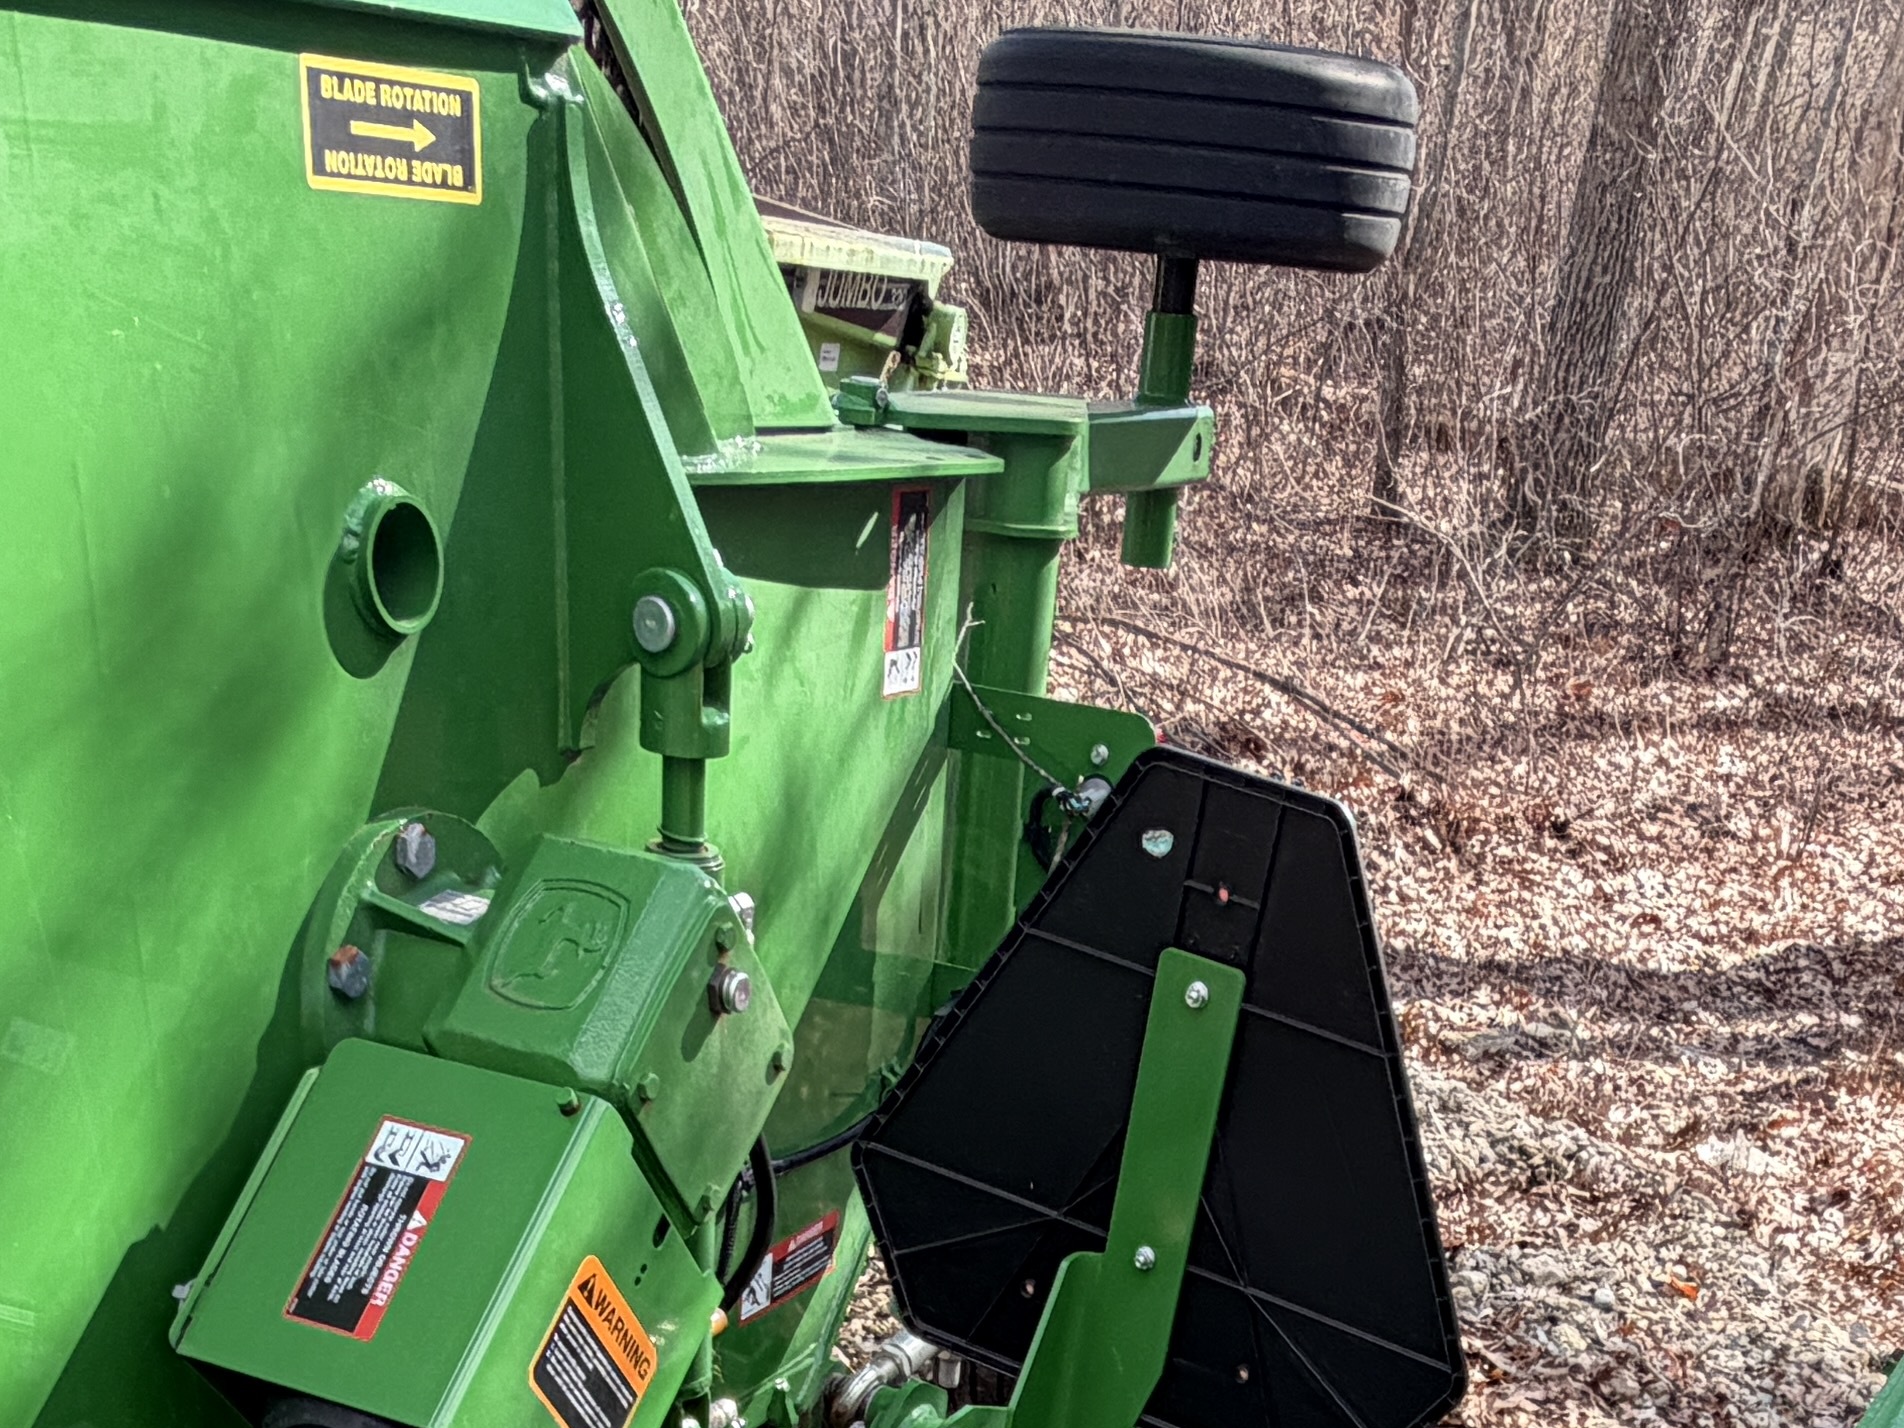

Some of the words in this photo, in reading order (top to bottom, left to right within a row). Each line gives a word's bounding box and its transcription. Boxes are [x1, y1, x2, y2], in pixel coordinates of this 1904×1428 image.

[320, 74, 377, 106] BLADE
[379, 83, 462, 118] ROTATION
[324, 149, 408, 182] ROTATION
[411, 161, 464, 187] BLADE
[370, 1232, 419, 1306] DANGER
[590, 1286, 653, 1383] WARNING
